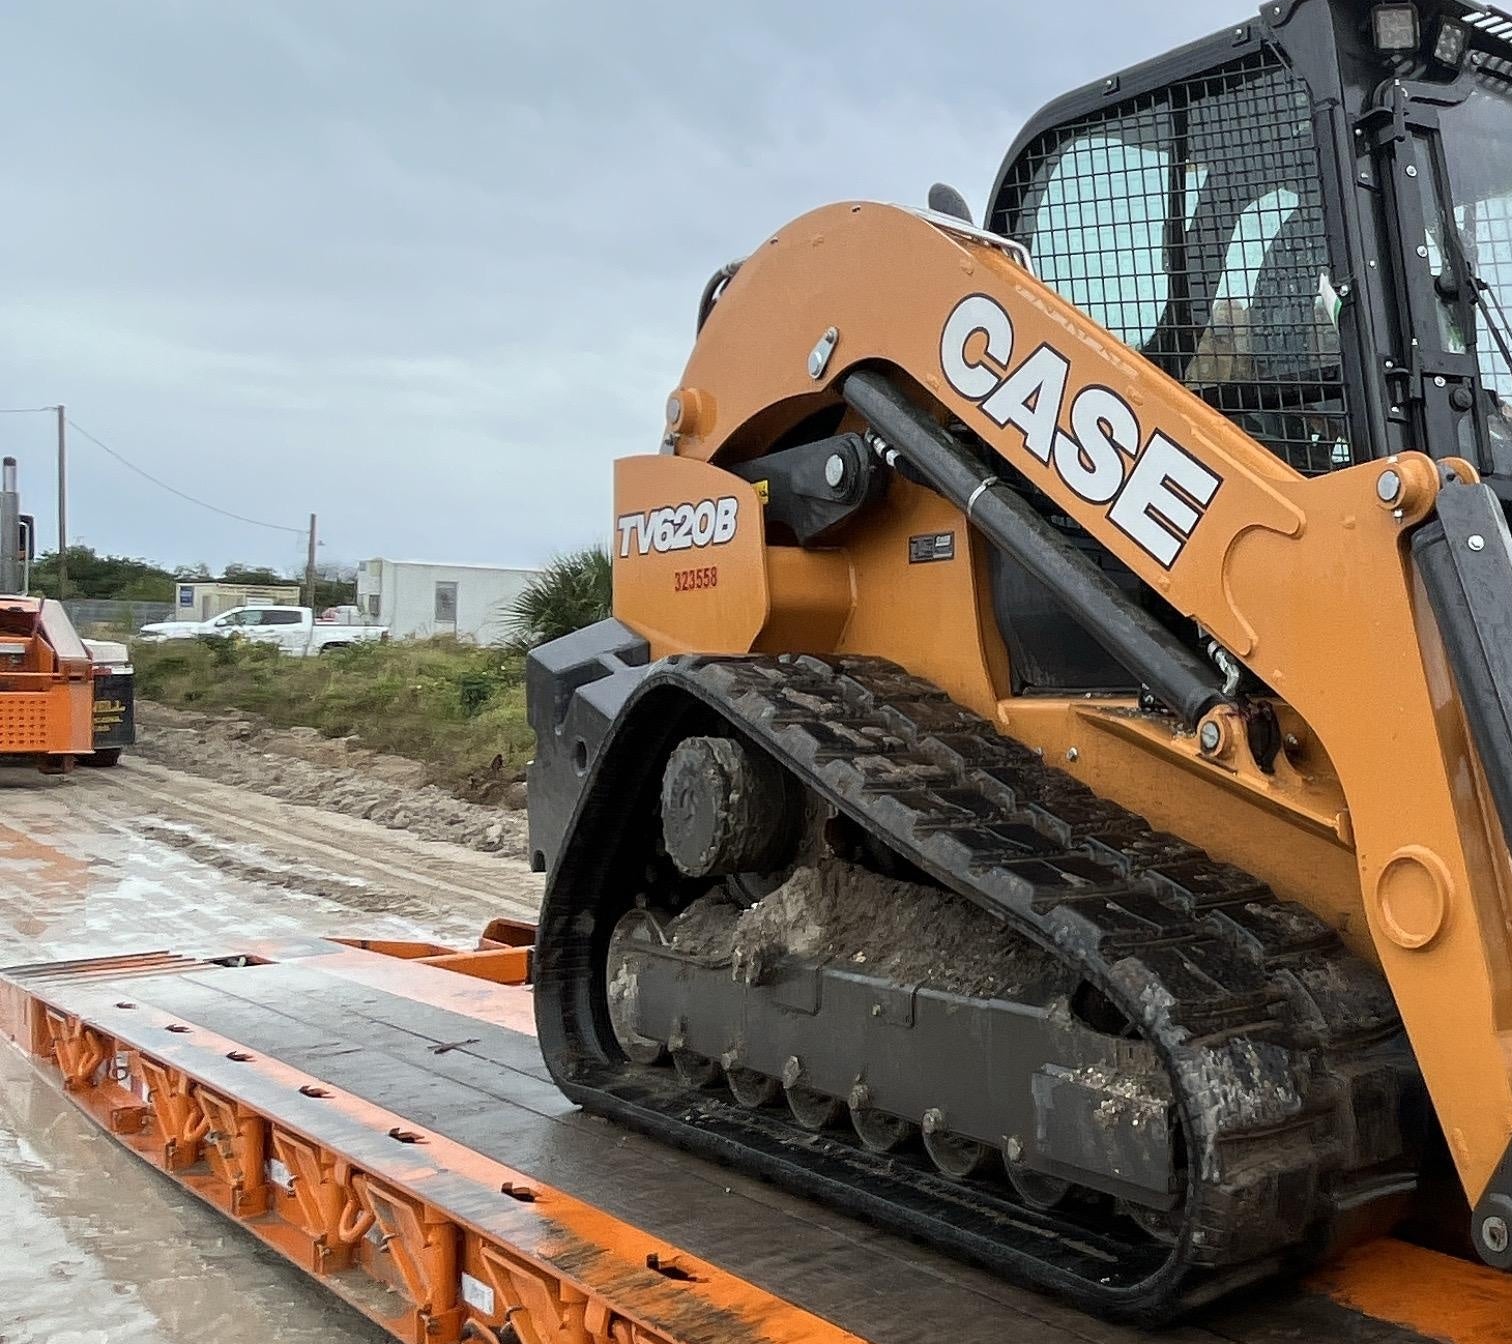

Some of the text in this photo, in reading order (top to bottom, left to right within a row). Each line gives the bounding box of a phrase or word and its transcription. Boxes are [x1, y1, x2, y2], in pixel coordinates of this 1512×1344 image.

[940, 293, 1223, 570] CASE
[618, 496, 739, 558] TV620B
[674, 566, 718, 592] 323558
